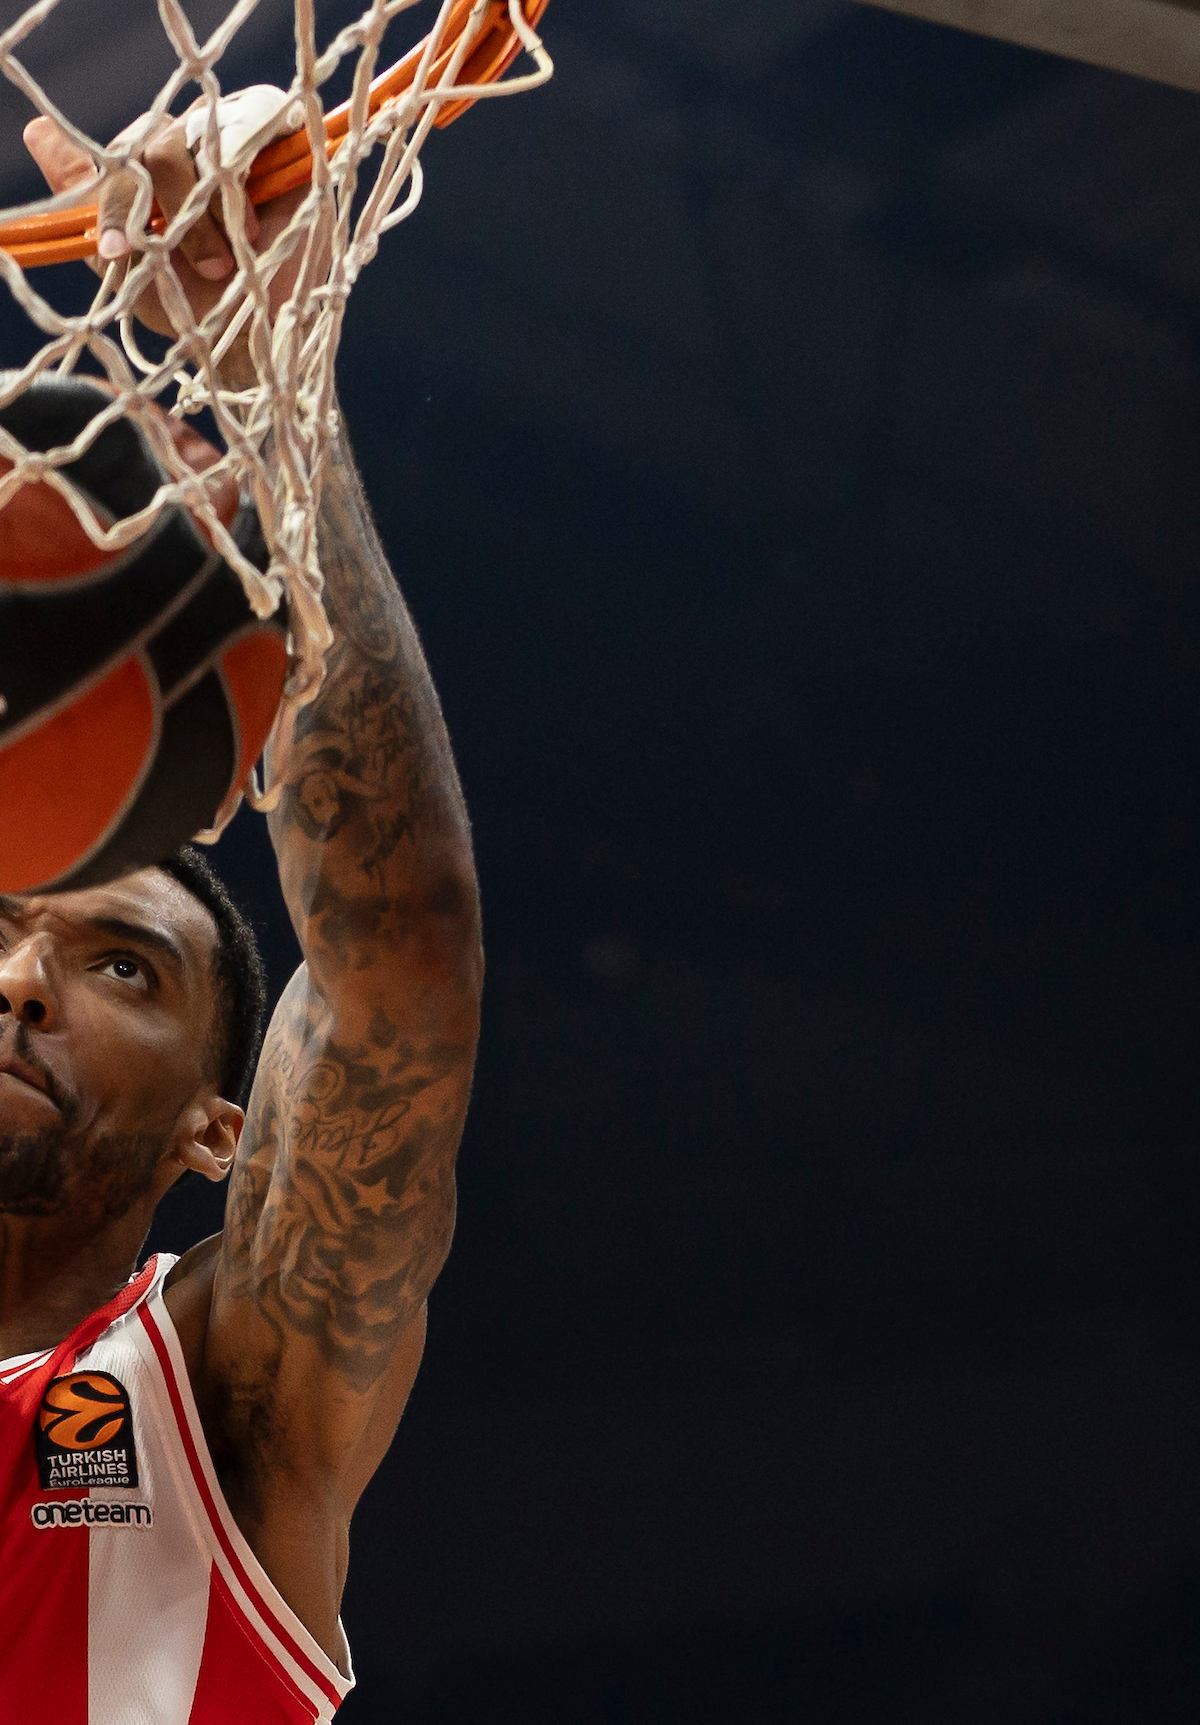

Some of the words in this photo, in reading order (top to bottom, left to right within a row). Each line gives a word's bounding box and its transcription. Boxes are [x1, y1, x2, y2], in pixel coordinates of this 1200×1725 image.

[47, 1449, 127, 1468] TURKISH
[49, 1462, 129, 1480] AIRLINES
[32, 1499, 151, 1526] oneteam
